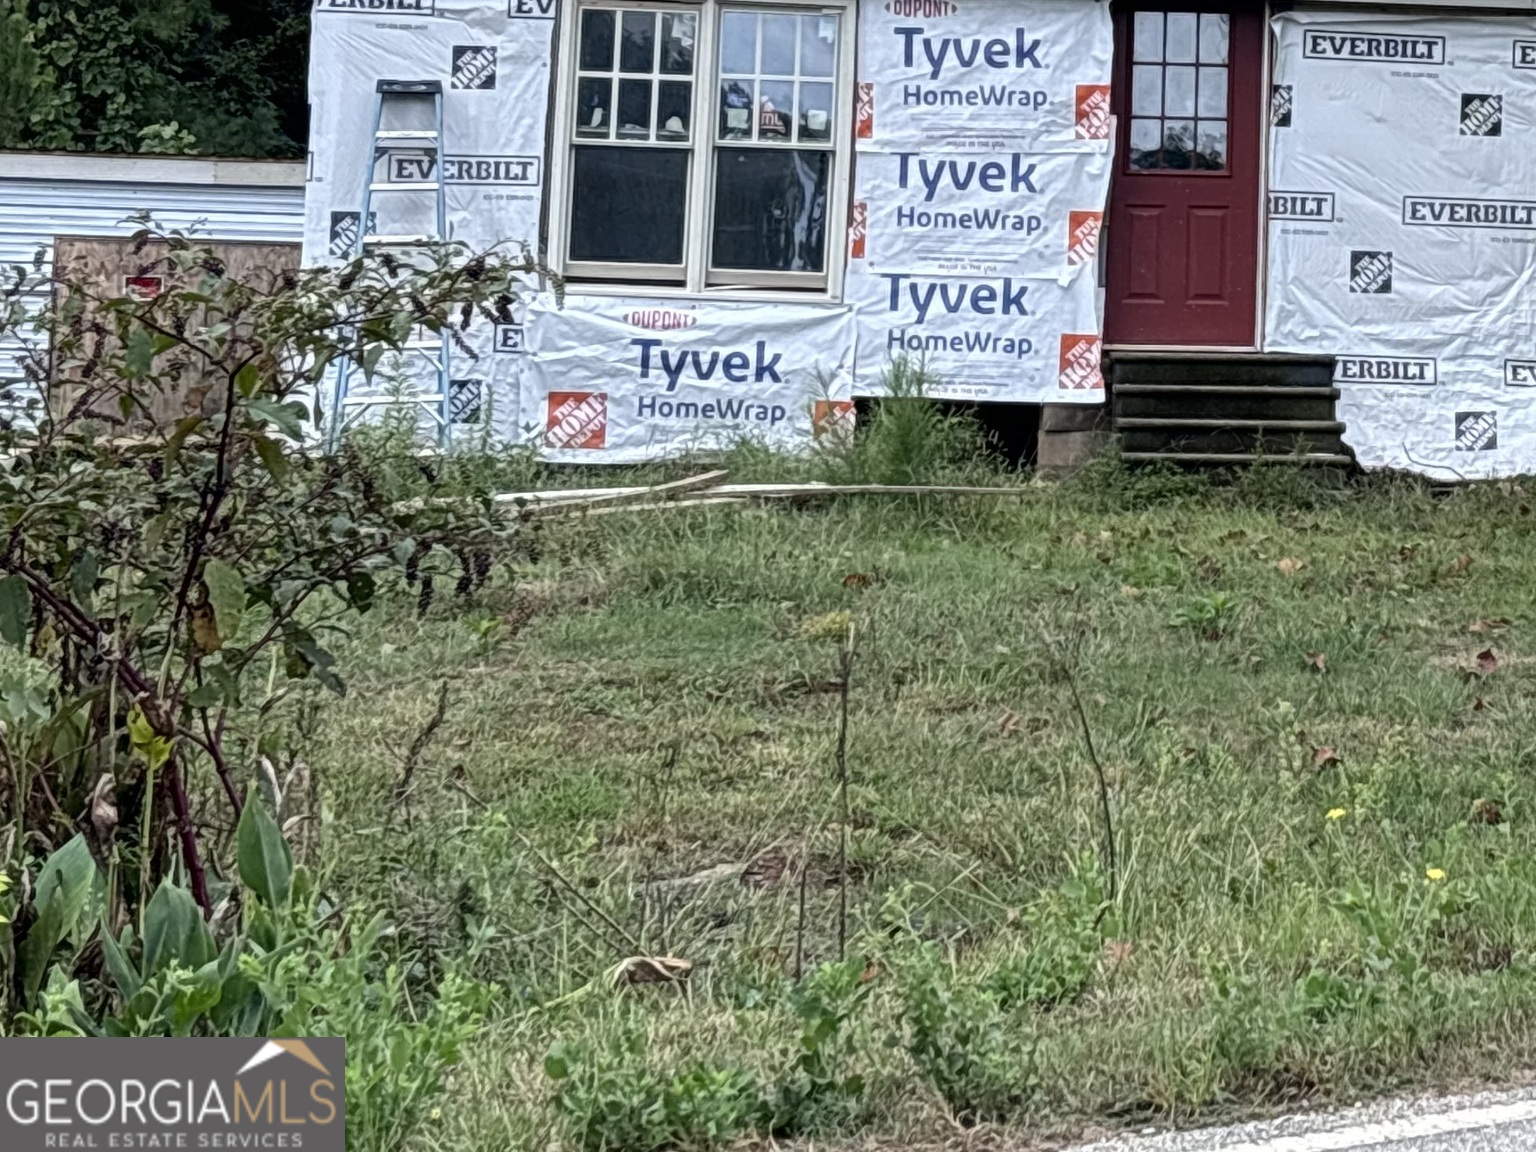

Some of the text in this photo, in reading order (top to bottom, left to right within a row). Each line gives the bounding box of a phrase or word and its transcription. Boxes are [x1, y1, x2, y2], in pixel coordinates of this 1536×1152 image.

[456, 49, 476, 68] THE
[894, 26, 1042, 80] Tyvek
[1310, 35, 1439, 60] EVERBILT
[451, 46, 498, 89] HOME
[470, 65, 497, 90] DEPOT
[903, 84, 1048, 111] HomeWrap
[1080, 90, 1103, 113] THE
[1465, 98, 1482, 115] THE
[1075, 92, 1112, 139] HO
[1459, 94, 1503, 136] HOME
[1476, 110, 1503, 136] DEPOT
[890, 152, 1037, 202] Tyvek
[334, 215, 354, 233] THE
[897, 205, 1042, 237] HomeWrap
[1350, 251, 1394, 293] HOME
[1355, 255, 1373, 272] THE
[1366, 270, 1393, 294] DEPOT
[880, 273, 1029, 324] Tyvek
[632, 310, 690, 330] DUPONT
[887, 329, 1033, 359] HomeWrap
[1065, 339, 1091, 363] THE
[630, 338, 783, 392] Tyvek
[1336, 360, 1430, 381] ERBILT
[546, 391, 608, 448] HOME
[553, 397, 579, 421] THE
[636, 396, 787, 425] HomeWrap
[569, 410, 608, 448] DEPOT
[1455, 411, 1497, 451] HOME
[1458, 416, 1476, 433] THE
[1472, 428, 1498, 452] DEPOT
